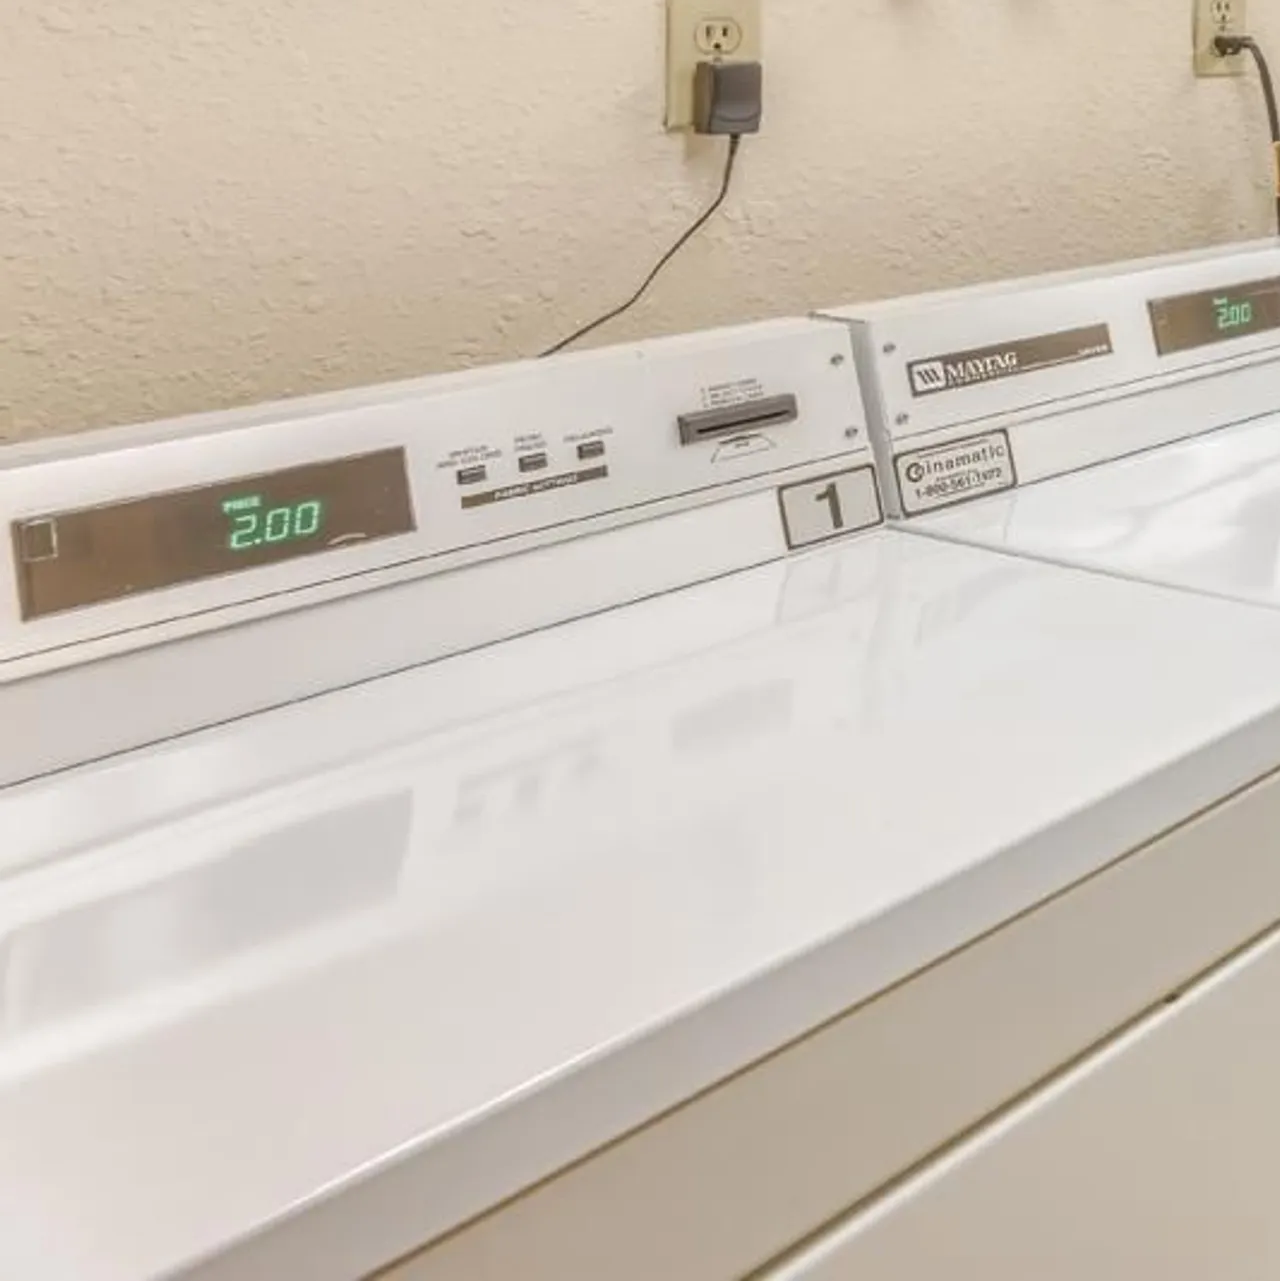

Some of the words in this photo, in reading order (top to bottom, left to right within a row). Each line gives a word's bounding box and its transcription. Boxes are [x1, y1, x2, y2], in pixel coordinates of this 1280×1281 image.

[945, 351, 1018, 379] MAYTAG
[230, 500, 321, 549] 2.00
[815, 482, 844, 529] 1
